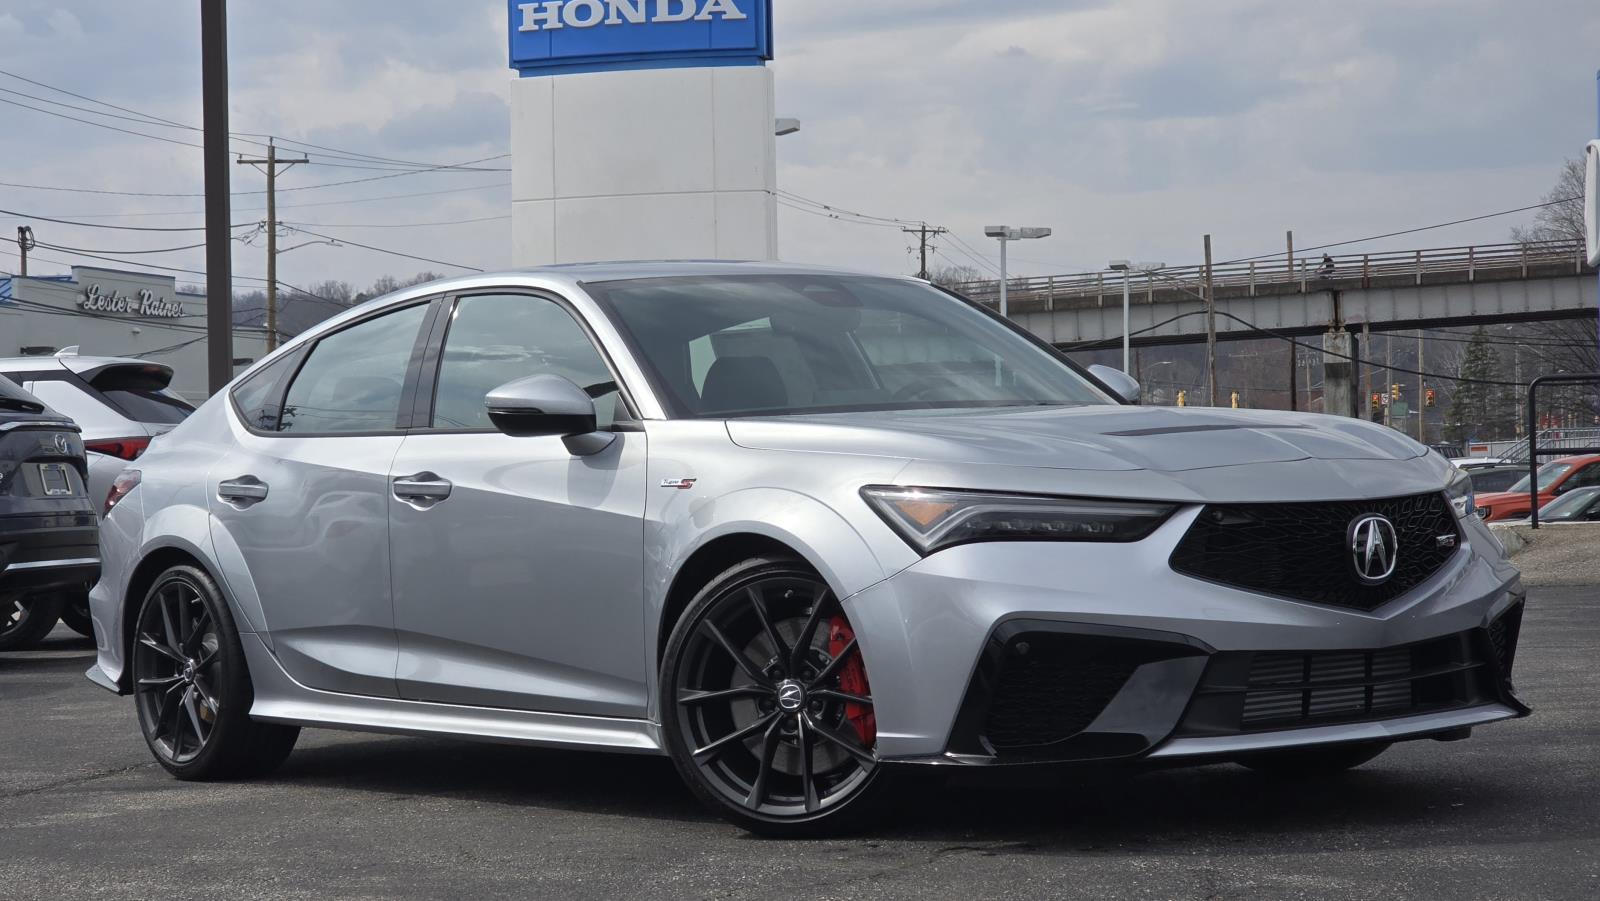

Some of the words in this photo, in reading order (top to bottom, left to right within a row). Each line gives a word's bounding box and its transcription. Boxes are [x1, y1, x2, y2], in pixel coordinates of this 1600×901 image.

[518, 0, 747, 32] HONDA
[77, 284, 133, 314] Lester
[136, 288, 187, 318] Raines
